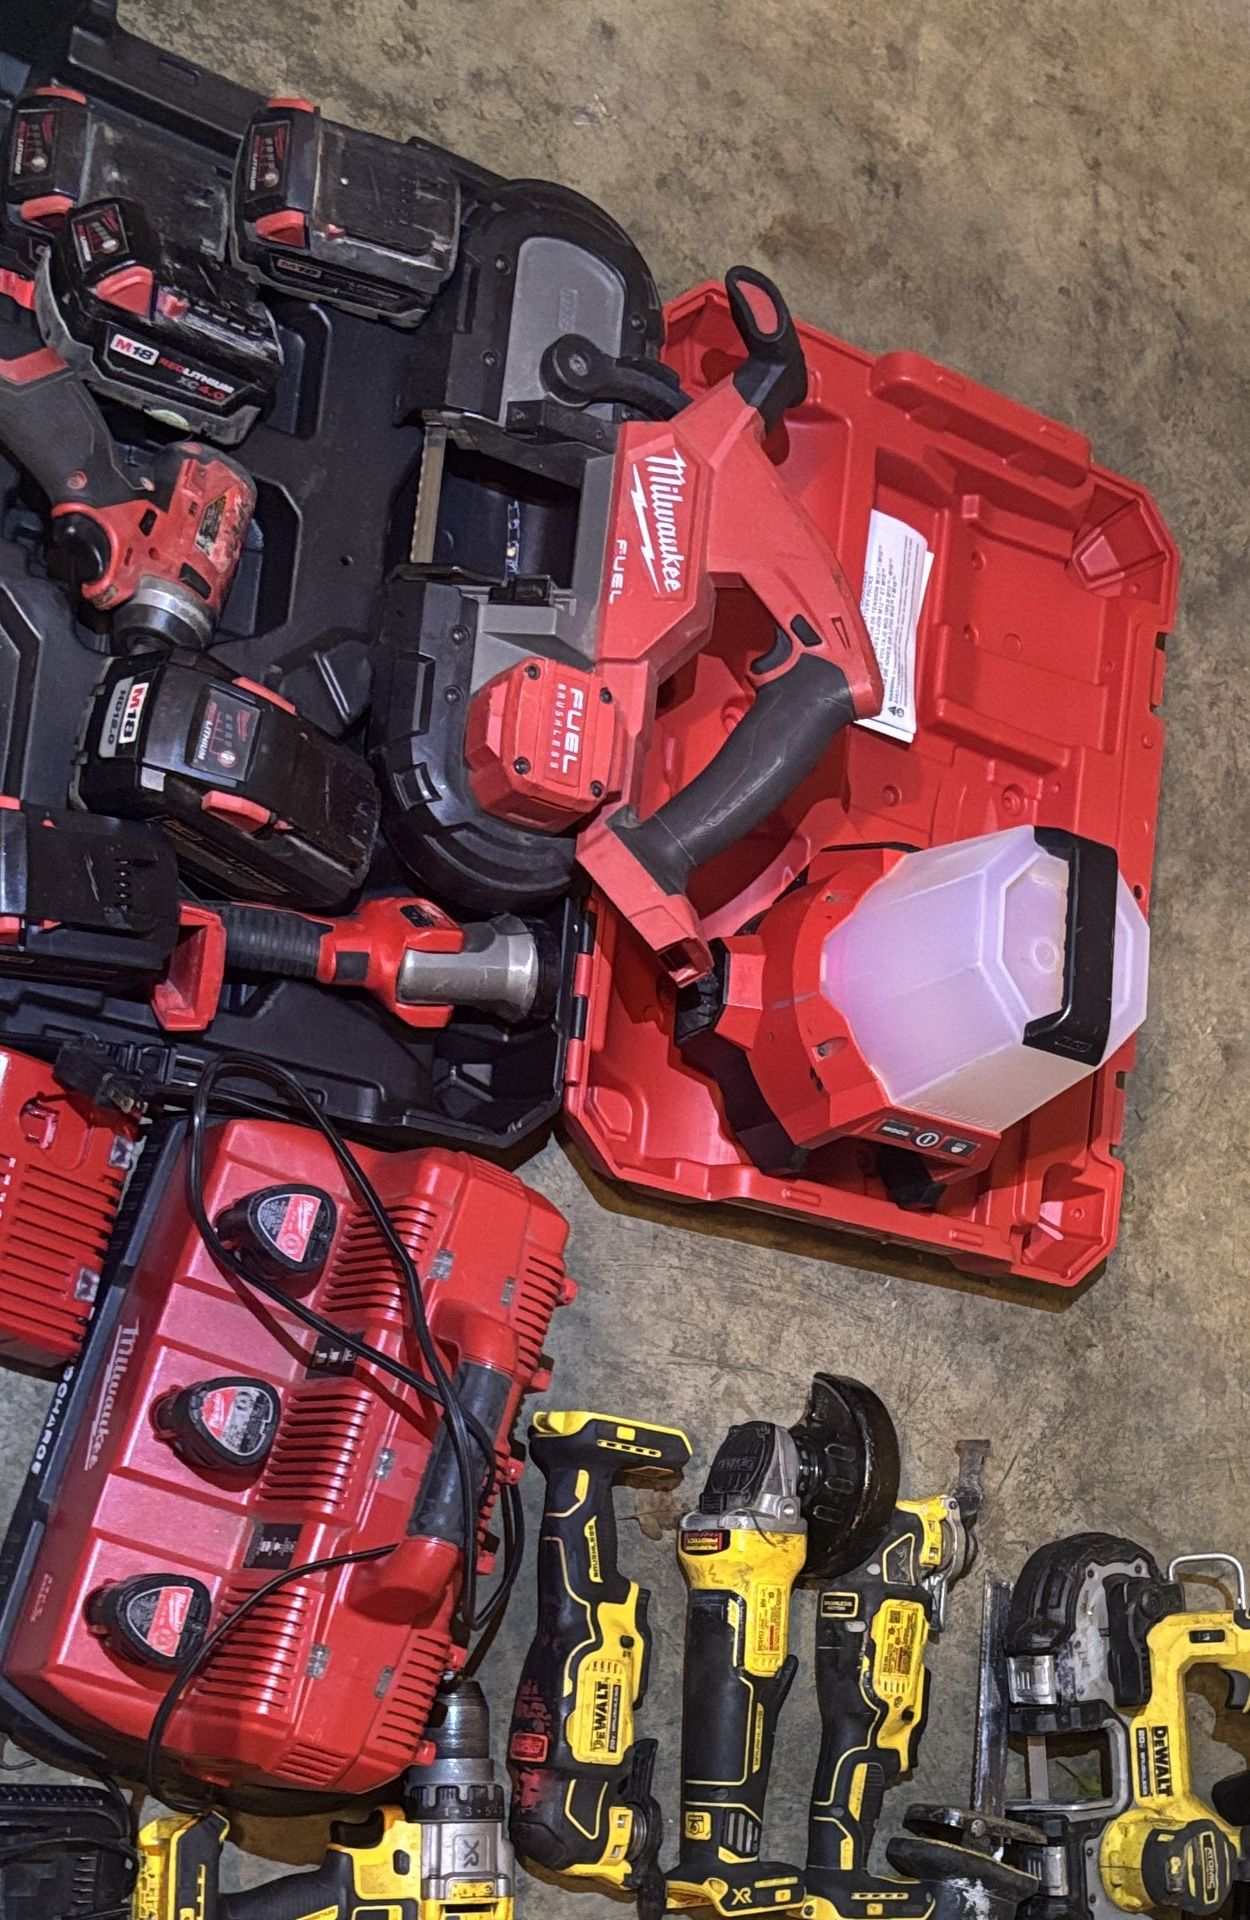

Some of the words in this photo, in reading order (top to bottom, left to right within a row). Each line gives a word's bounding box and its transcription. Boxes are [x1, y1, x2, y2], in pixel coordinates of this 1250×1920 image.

[115, 337, 154, 361] M18
[644, 448, 688, 593] Milwaukee
[609, 539, 628, 605] FUEL
[124, 687, 145, 738] M18
[549, 683, 567, 769] BRUSHLESS
[562, 687, 584, 774] FUEL
[88, 1317, 140, 1470] Milwaukee
[588, 1525, 599, 1578] BRUSHLESS
[593, 1680, 610, 1750] DEWALT
[1153, 1726, 1171, 1796] DEWALT
[463, 1840, 480, 1868] XR
[731, 1887, 752, 1906] XR
